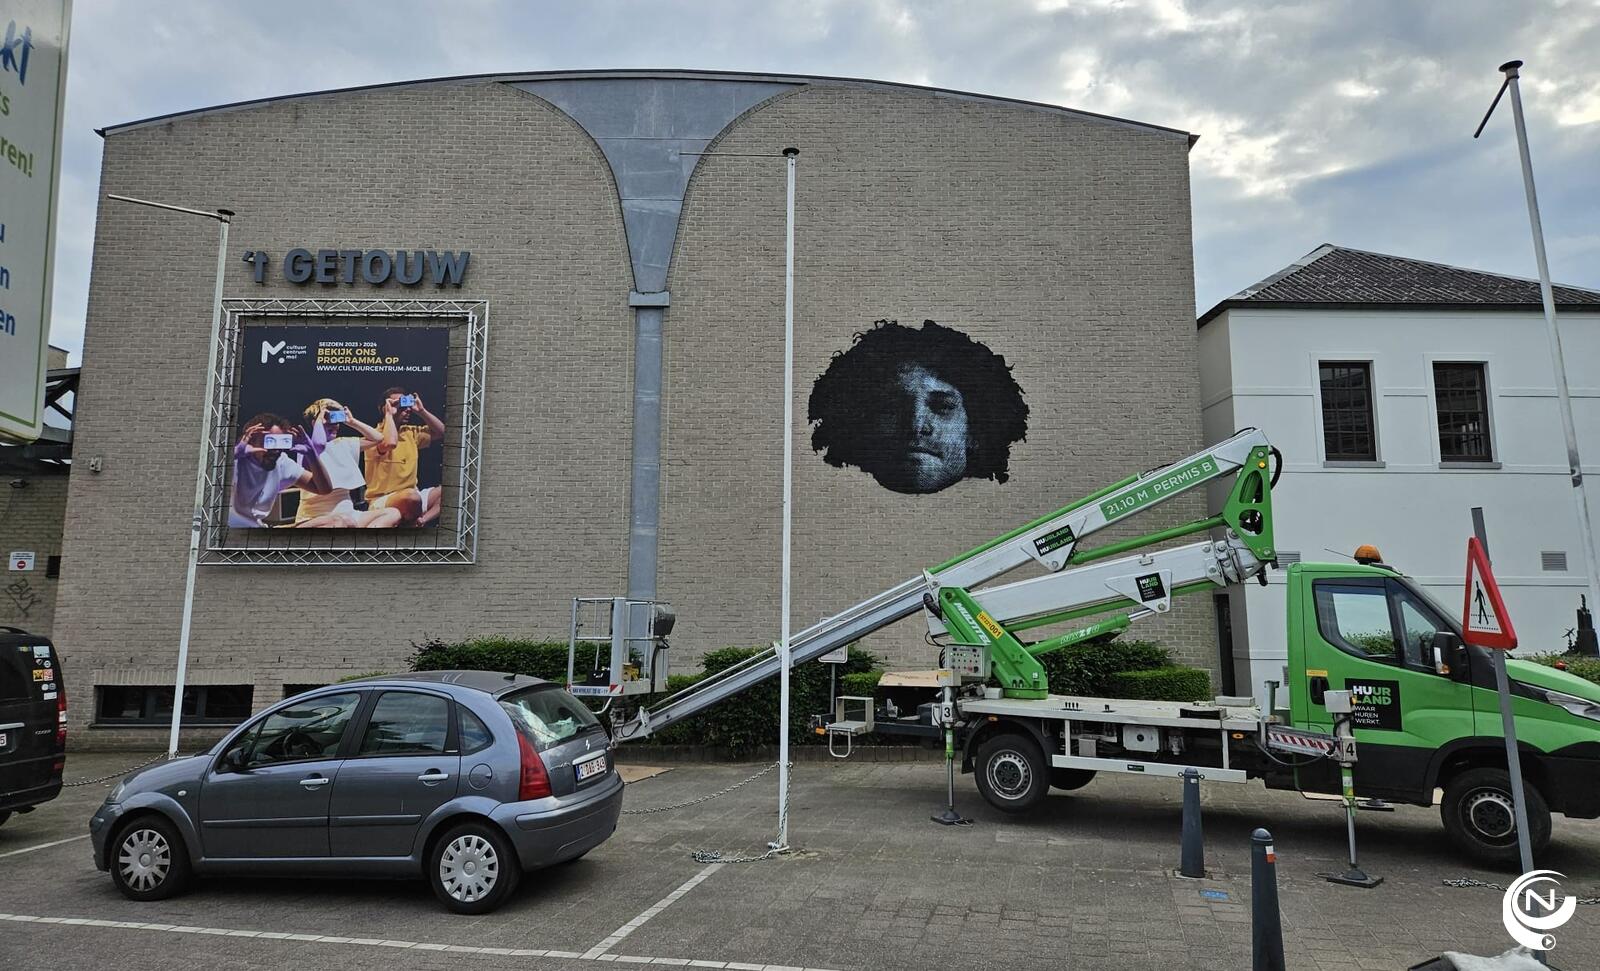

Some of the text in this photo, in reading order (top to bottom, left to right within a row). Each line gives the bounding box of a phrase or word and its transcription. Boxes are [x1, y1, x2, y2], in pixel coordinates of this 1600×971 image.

[284, 248, 470, 287] GETOUW
[317, 348, 377, 356] BEKIJK ONS
[317, 356, 400, 365] PROGRAMMA OP
[1106, 461, 1213, 515] 21.10 M PERMIS B
[1035, 527, 1069, 546] HUURLAND
[1039, 536, 1073, 554] HUURLAND
[1352, 685, 1391, 696] HUUR
[1355, 695, 1392, 705] LAND
[943, 707, 951, 718] 3
[1346, 743, 1355, 756] 4
